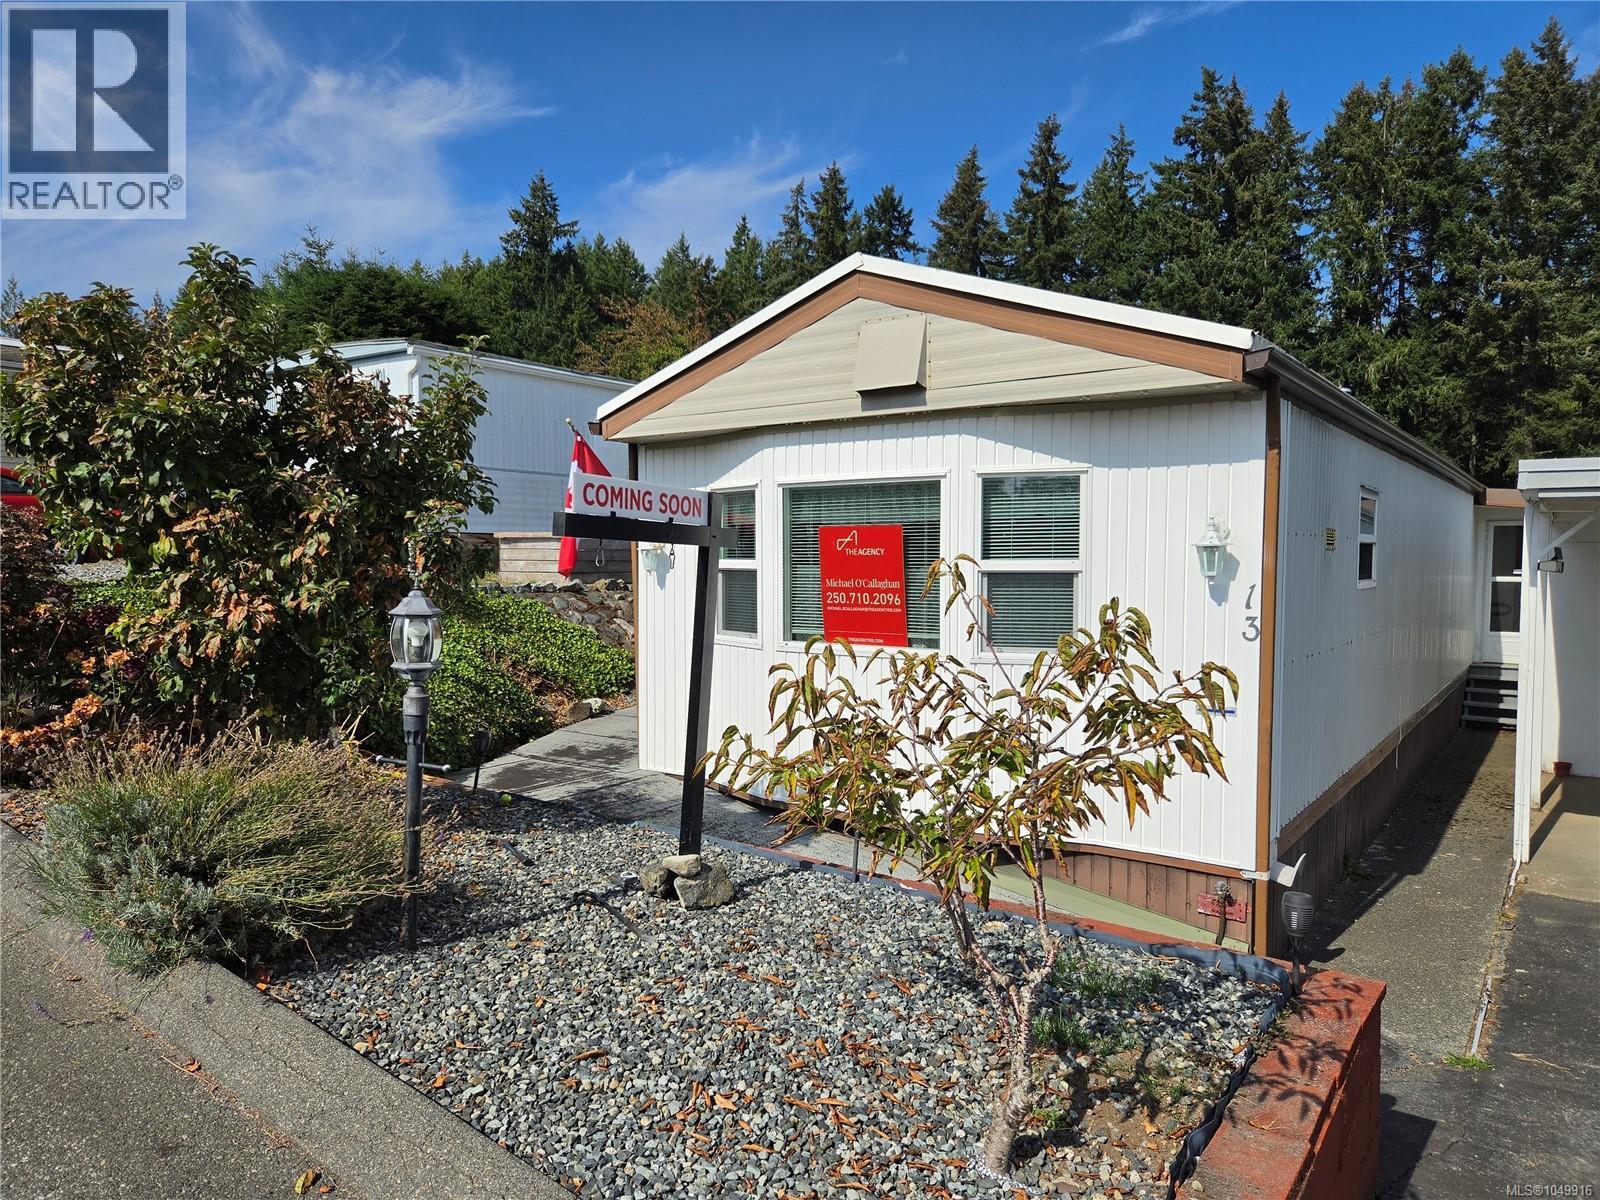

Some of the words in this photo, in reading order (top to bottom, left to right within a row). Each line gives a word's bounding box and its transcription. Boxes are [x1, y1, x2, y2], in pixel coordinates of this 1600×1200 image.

[583, 482, 653, 512] COMING
[659, 493, 702, 518] SOON
[826, 579, 854, 588] Michael
[855, 579, 900, 590] O'Callaghan
[827, 592, 901, 605] 250.710.2096
